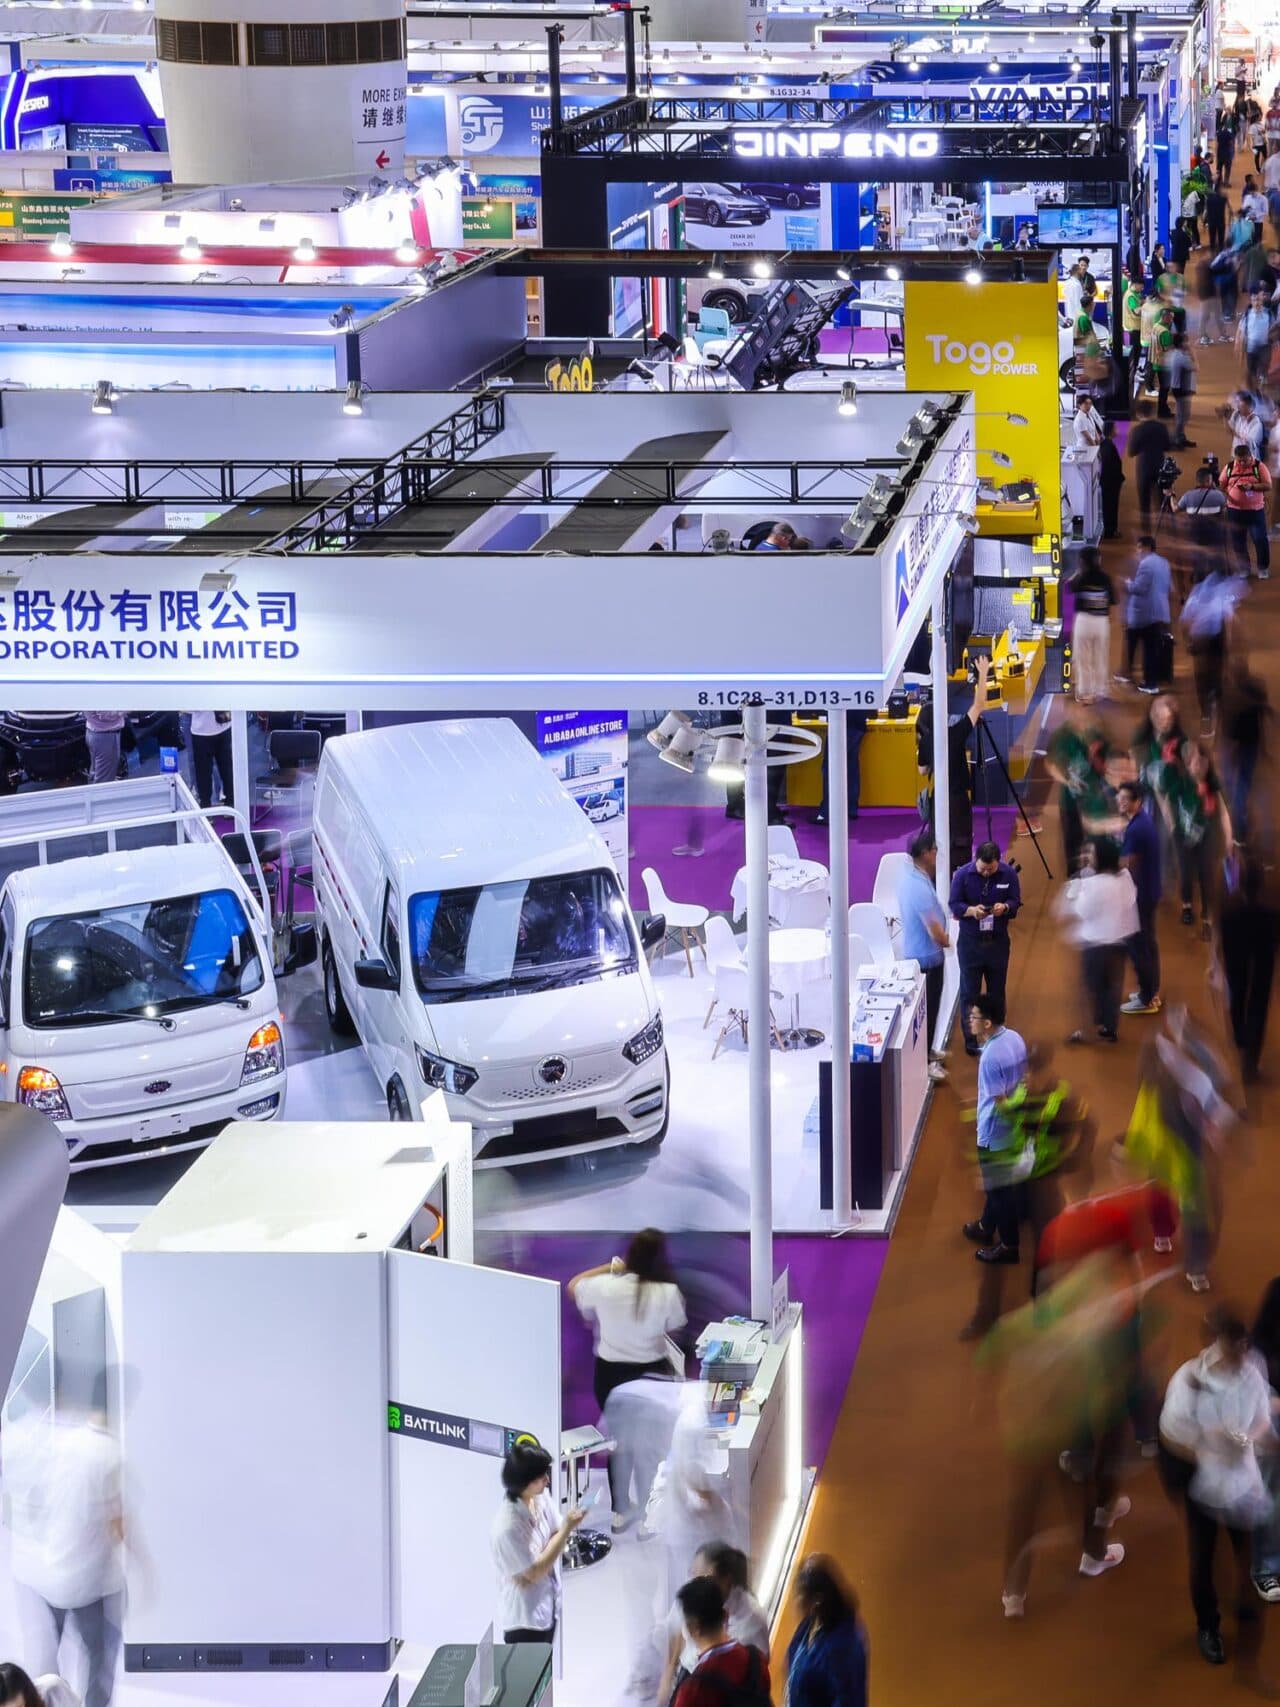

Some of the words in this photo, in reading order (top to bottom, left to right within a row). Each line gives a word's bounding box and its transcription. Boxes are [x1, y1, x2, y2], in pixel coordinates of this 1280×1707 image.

[362, 88, 391, 103] MORE
[925, 334, 1015, 375] Togo
[993, 363, 1038, 375] POWER
[187, 641, 299, 659] LIMITED
[544, 729, 575, 744] ALIBABA
[576, 723, 600, 737] ONLINE
[600, 719, 623, 733] STORE
[404, 1414, 466, 1440] BATTLINK
